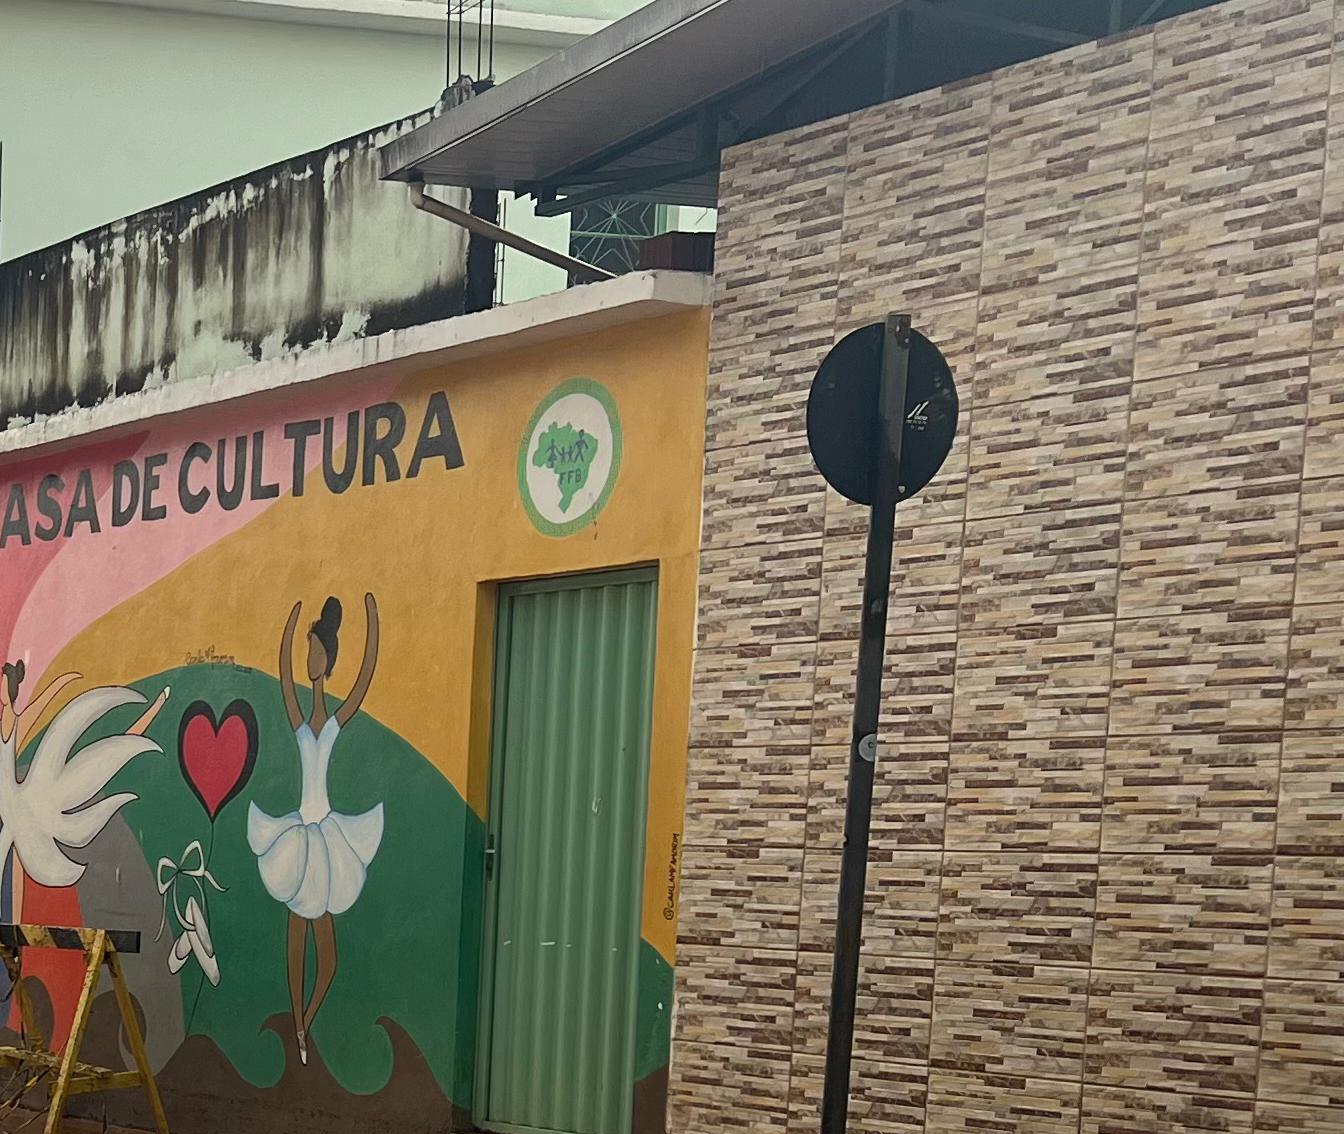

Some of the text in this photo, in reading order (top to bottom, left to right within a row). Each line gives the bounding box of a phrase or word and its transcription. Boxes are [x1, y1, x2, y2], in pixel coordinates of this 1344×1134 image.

[111, 452, 169, 528] DE
[177, 391, 465, 514] CULTURA
[560, 469, 582, 485] FFB
